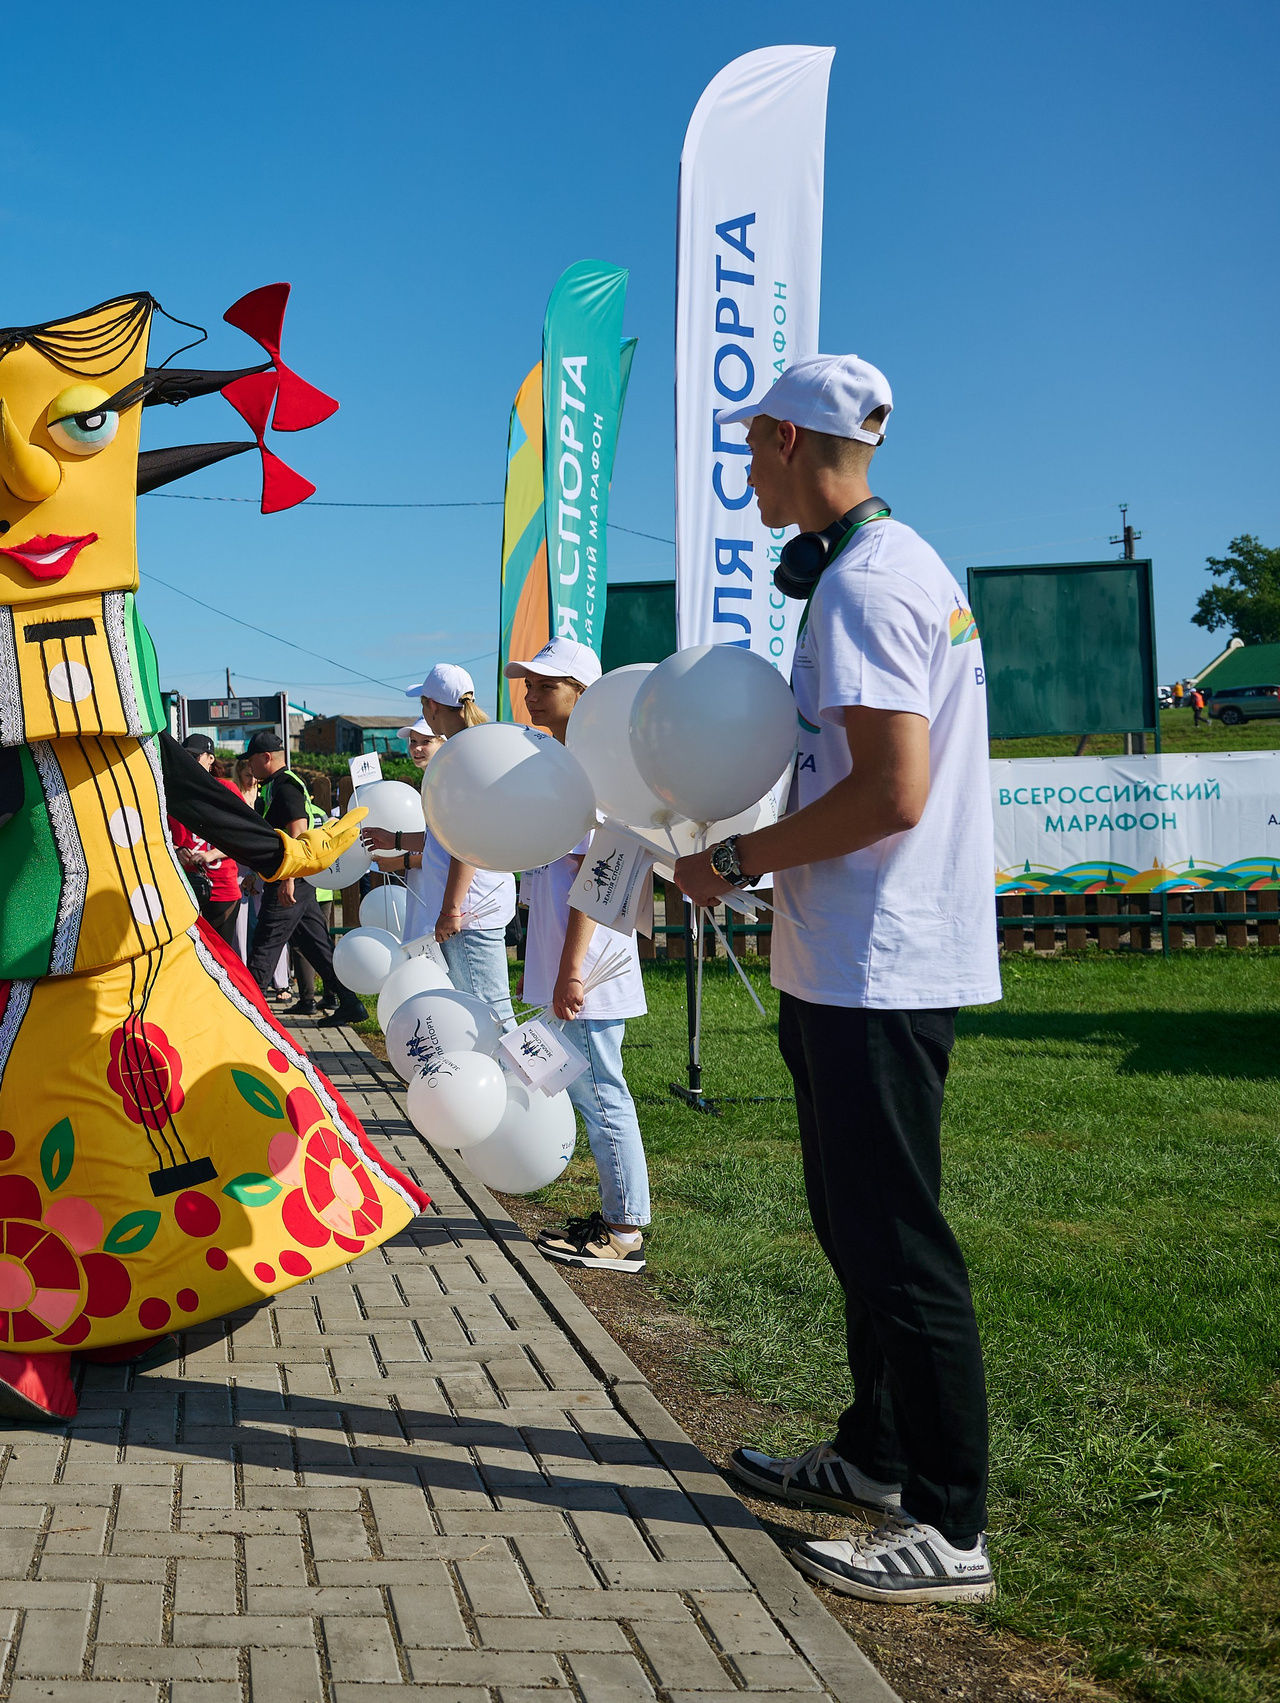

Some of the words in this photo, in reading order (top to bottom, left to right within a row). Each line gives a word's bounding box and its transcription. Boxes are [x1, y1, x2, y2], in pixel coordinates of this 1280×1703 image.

[772, 281, 787, 386] АФОН
[557, 356, 588, 586] СПОРТА
[588, 412, 604, 540] МАРАФОН
[999, 778, 1220, 806] ВСЕРОССИЙСКИЙ
[1045, 812, 1177, 833] МАРАФОН
[602, 882, 615, 906] ЗЕМЛЯ
[611, 853, 624, 881] СПОРТА
[426, 1015, 439, 1045] СПОРТА
